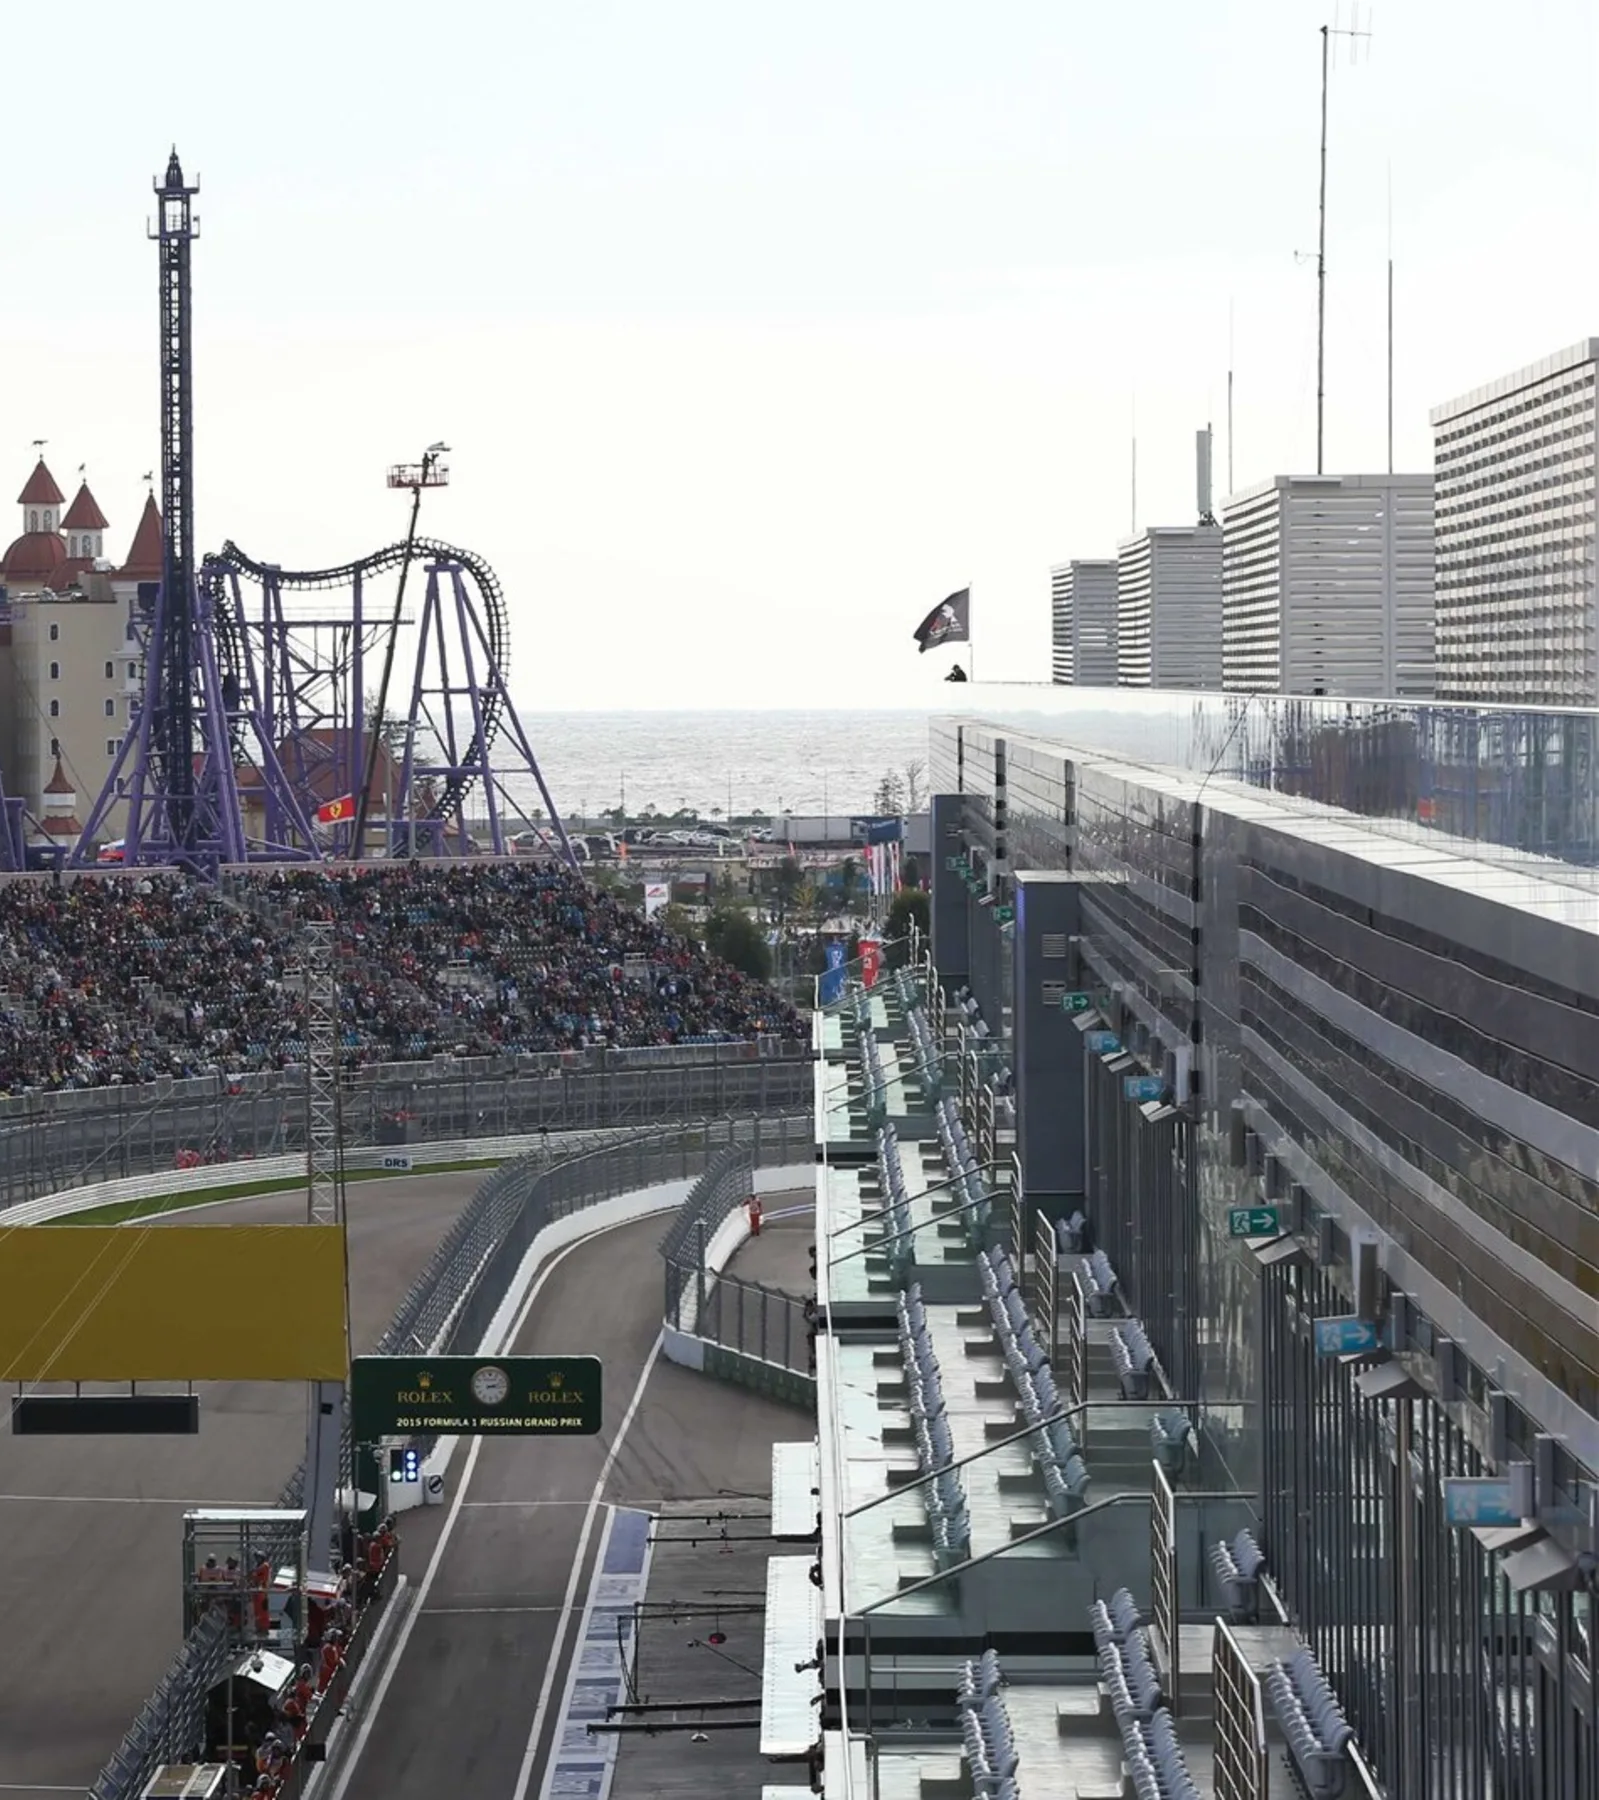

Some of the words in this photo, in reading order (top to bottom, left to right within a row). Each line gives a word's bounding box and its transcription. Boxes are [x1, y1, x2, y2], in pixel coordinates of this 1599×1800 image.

[384, 1158, 408, 1168] DRS
[397, 1391, 453, 1403] ROLEX
[528, 1391, 584, 1403] ROLEX
[396, 1417, 422, 1427] 2015
[423, 1417, 469, 1427] FORMULA
[480, 1417, 522, 1427] RUSSIAN
[524, 1417, 559, 1427] GRAND
[560, 1417, 583, 1427] PRIX
